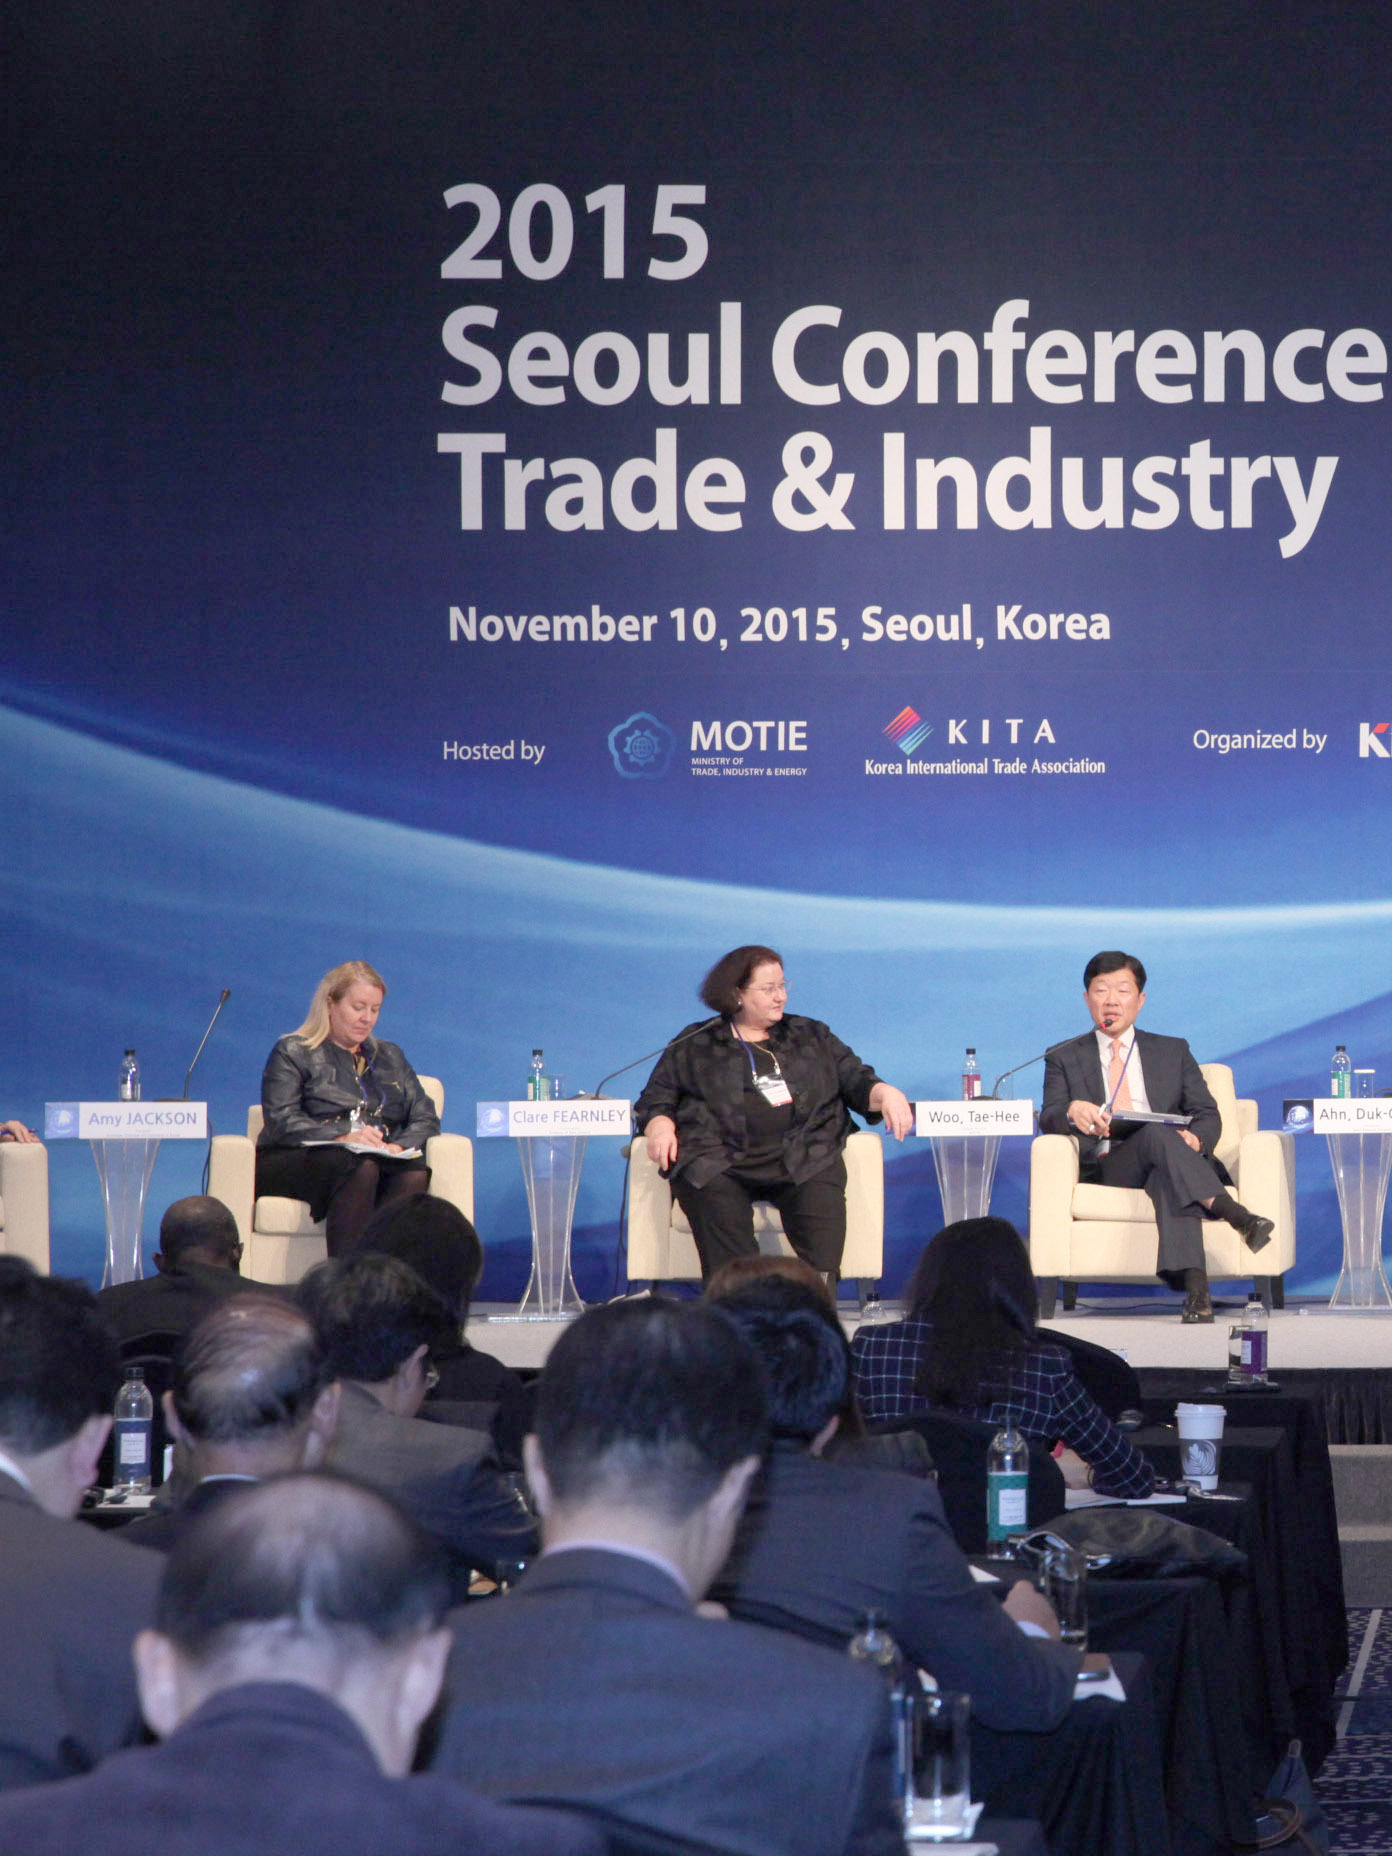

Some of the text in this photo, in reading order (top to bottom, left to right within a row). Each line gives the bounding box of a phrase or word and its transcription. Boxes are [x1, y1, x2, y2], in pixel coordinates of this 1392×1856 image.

[440, 183, 709, 280] 2015
[440, 301, 742, 406] Seoul
[772, 299, 1388, 406] Conference
[437, 426, 1340, 559] Trade & Industry
[448, 604, 1111, 651] November 10, 2015, Seoul, Korea
[690, 720, 808, 751] MOTIE
[1193, 728, 1328, 754] Organized by
[443, 739, 546, 765] Hosted by
[691, 757, 744, 766] MINISTRY OF
[691, 767, 807, 777] TRADE, INDUSTRY & ENERGY
[865, 757, 1106, 775] Korea International Trade Association
[88, 1111, 197, 1128] Amy JACKSON
[513, 1109, 626, 1124] Clare FEARNLEY
[928, 1110, 1020, 1125] Woo, Tae-Hee
[1319, 1107, 1351, 1122] Ahn,
